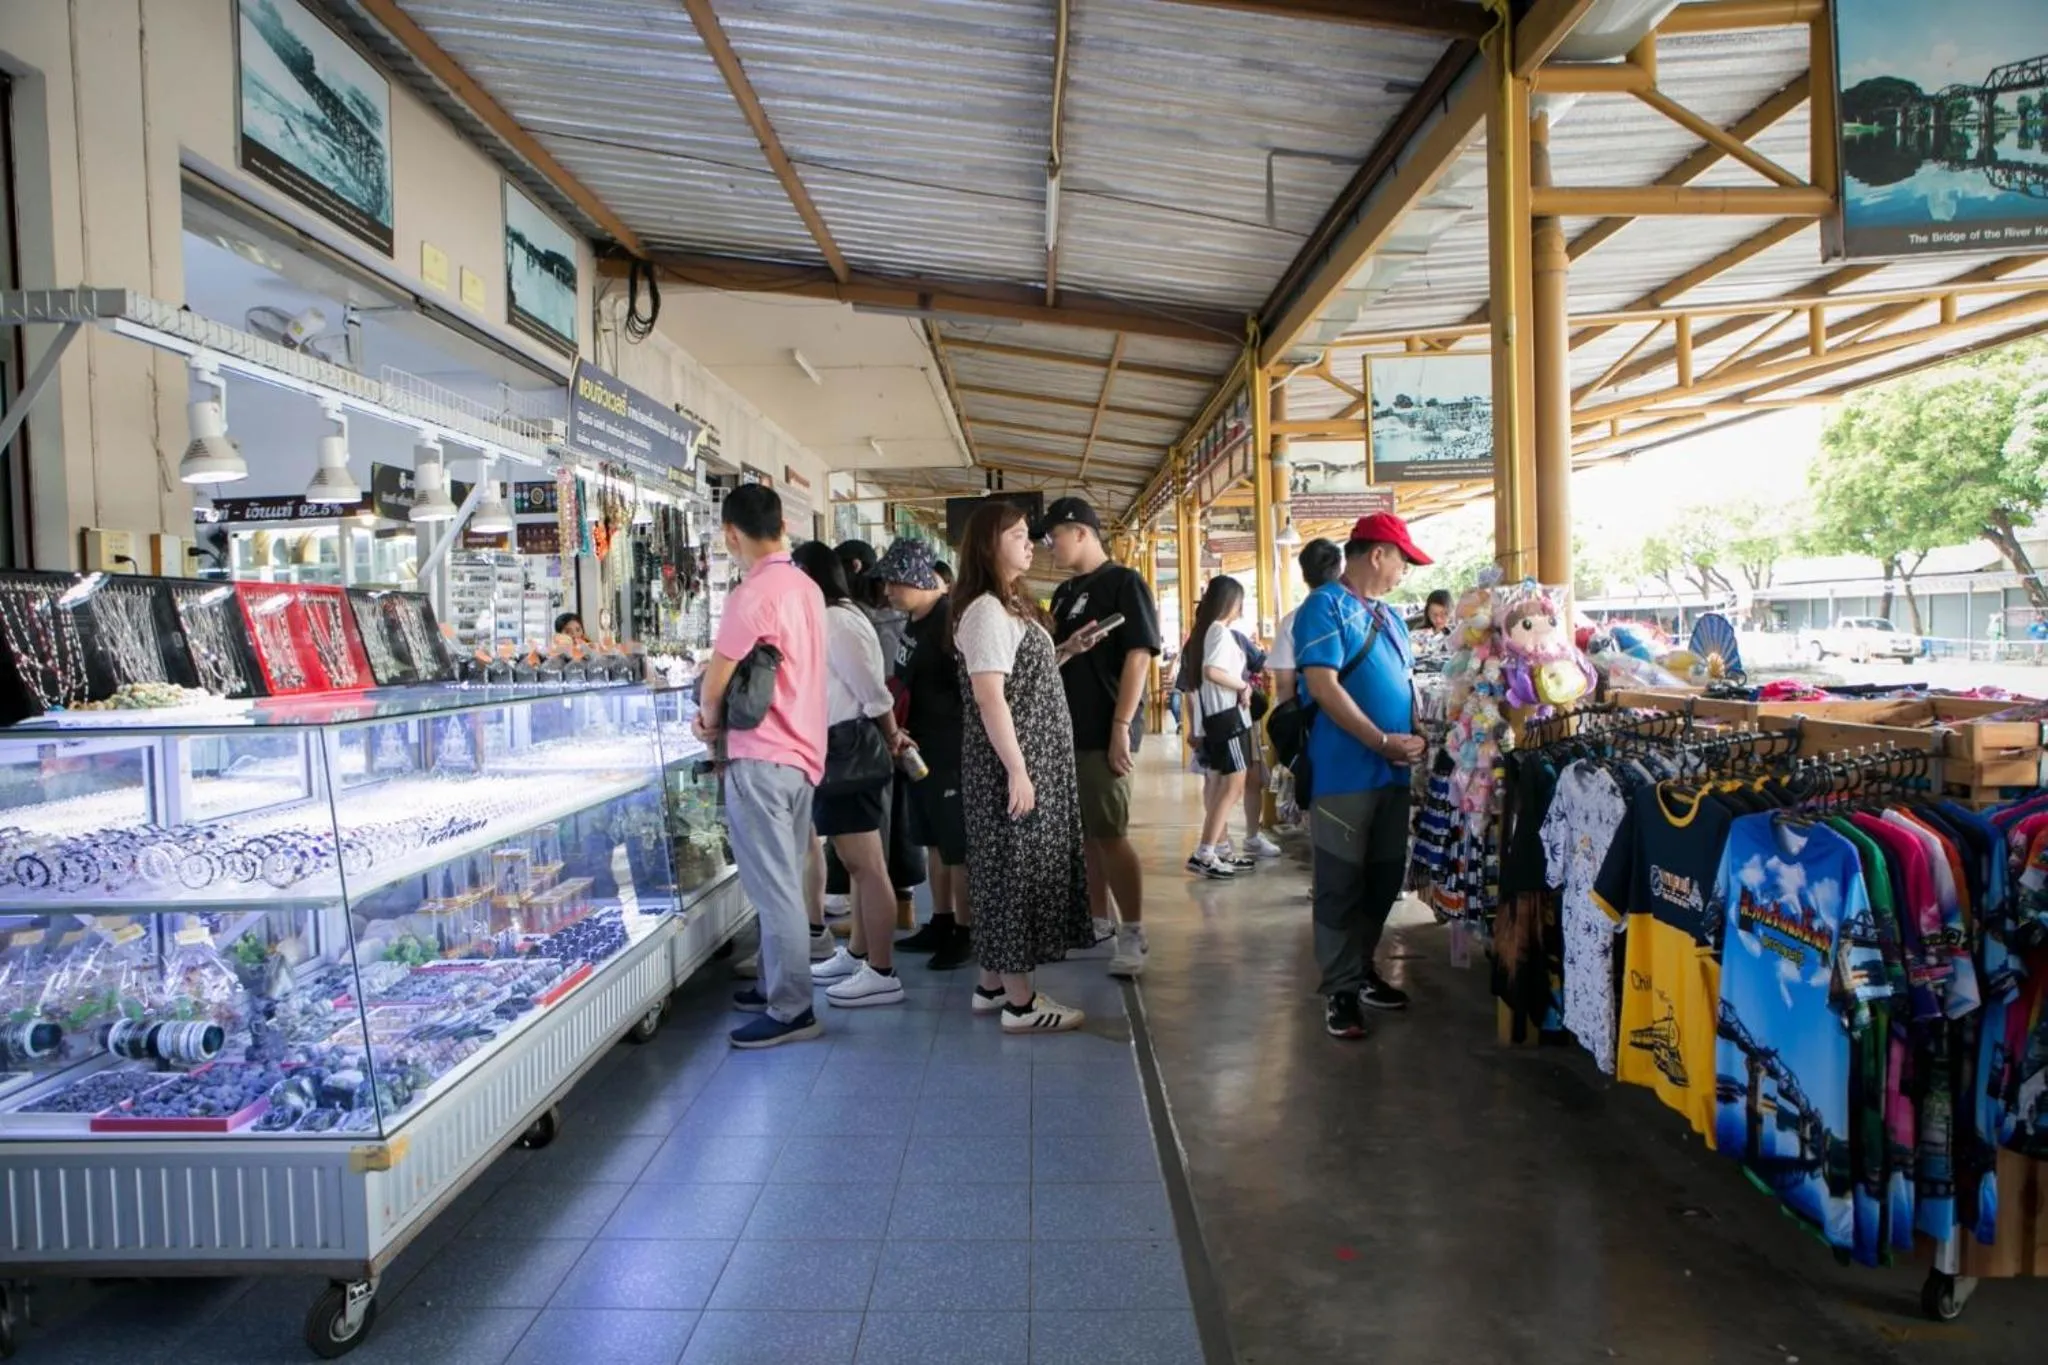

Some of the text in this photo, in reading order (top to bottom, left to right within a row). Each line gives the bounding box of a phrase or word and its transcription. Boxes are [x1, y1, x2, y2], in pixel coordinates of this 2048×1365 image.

[1908, 233, 1928, 245] The
[1932, 231, 1966, 244] Bridge
[1969, 230, 1981, 241] of
[1984, 229, 2001, 240] the
[2004, 227, 2032, 238] River
